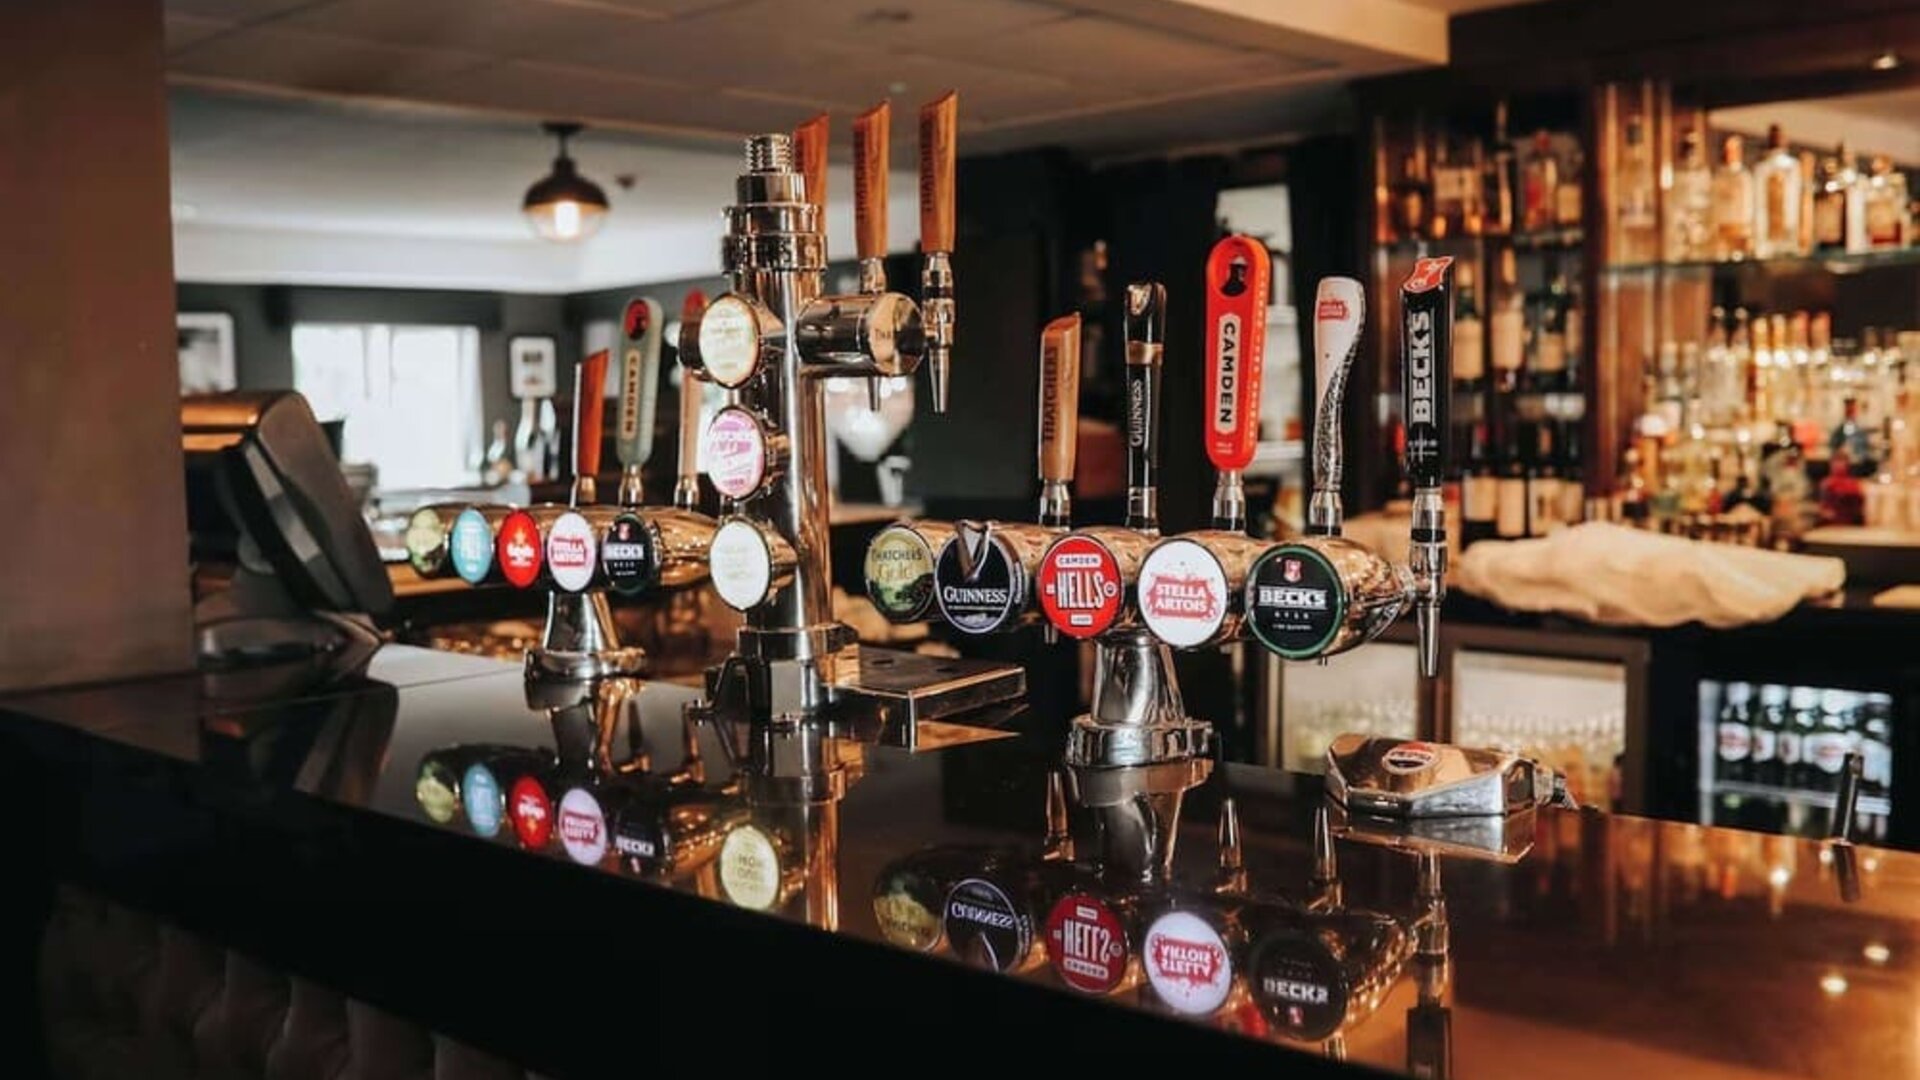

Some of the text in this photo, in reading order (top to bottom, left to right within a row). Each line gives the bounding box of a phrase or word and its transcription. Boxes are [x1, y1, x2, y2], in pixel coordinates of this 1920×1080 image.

[1220, 321, 1236, 424] CAMDEN
[1130, 378, 1143, 447] GUINNESS
[871, 548, 923, 561] THATCHERS
[1058, 556, 1099, 566] CAMDEN
[943, 585, 1008, 605] GUINNESS
[1056, 570, 1105, 609] HELLS
[1155, 583, 1207, 600] STELLA
[1154, 597, 1208, 613] ARTOIS
